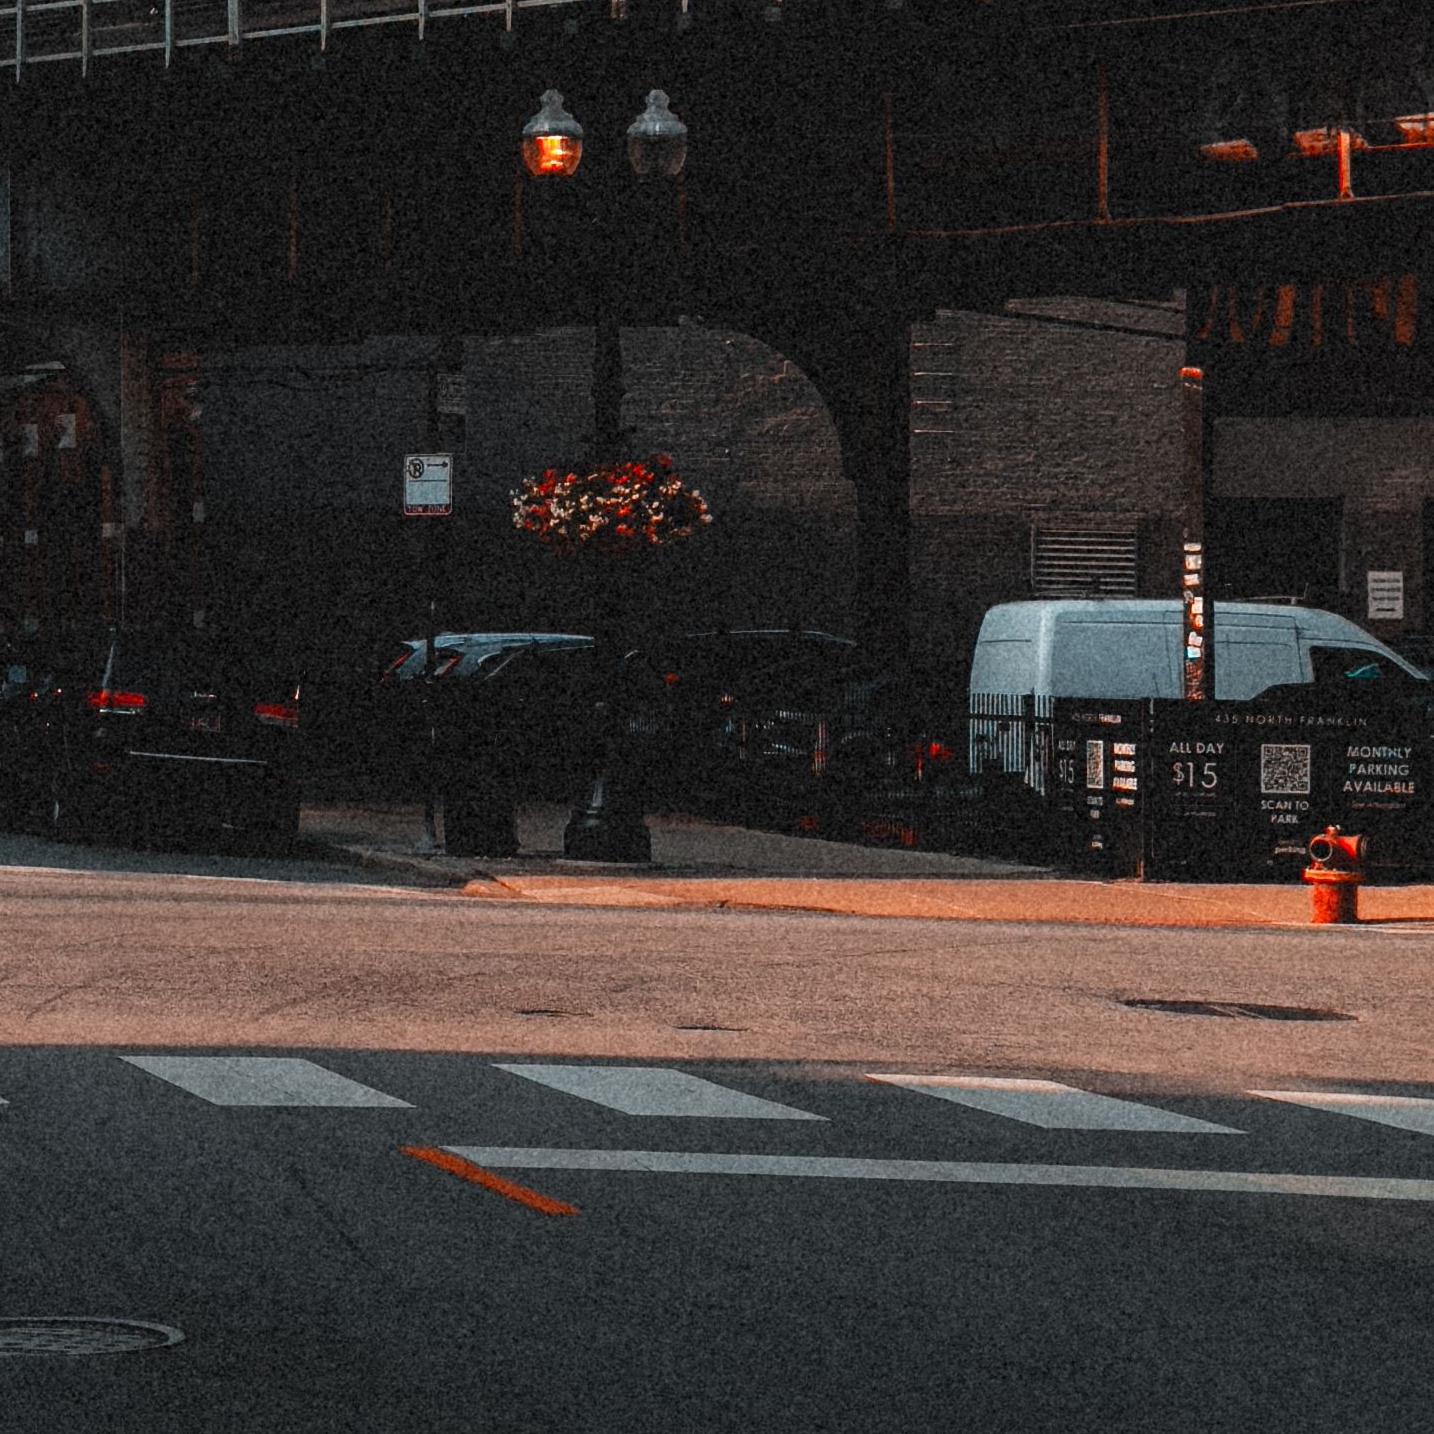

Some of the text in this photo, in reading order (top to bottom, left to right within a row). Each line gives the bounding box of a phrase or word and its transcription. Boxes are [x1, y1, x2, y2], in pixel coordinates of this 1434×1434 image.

[1245, 714, 1293, 727] NORTH
[1299, 714, 1369, 728] FRANKLIN
[1169, 741, 1225, 755] ALL DAY
[1346, 745, 1413, 759] MONTHLY
[1172, 760, 1219, 790] $15
[1348, 763, 1410, 777] PARKING
[1342, 779, 1416, 794] AVAILABLE
[1260, 799, 1310, 811] SCAN TO
[1270, 814, 1300, 825] PARK
